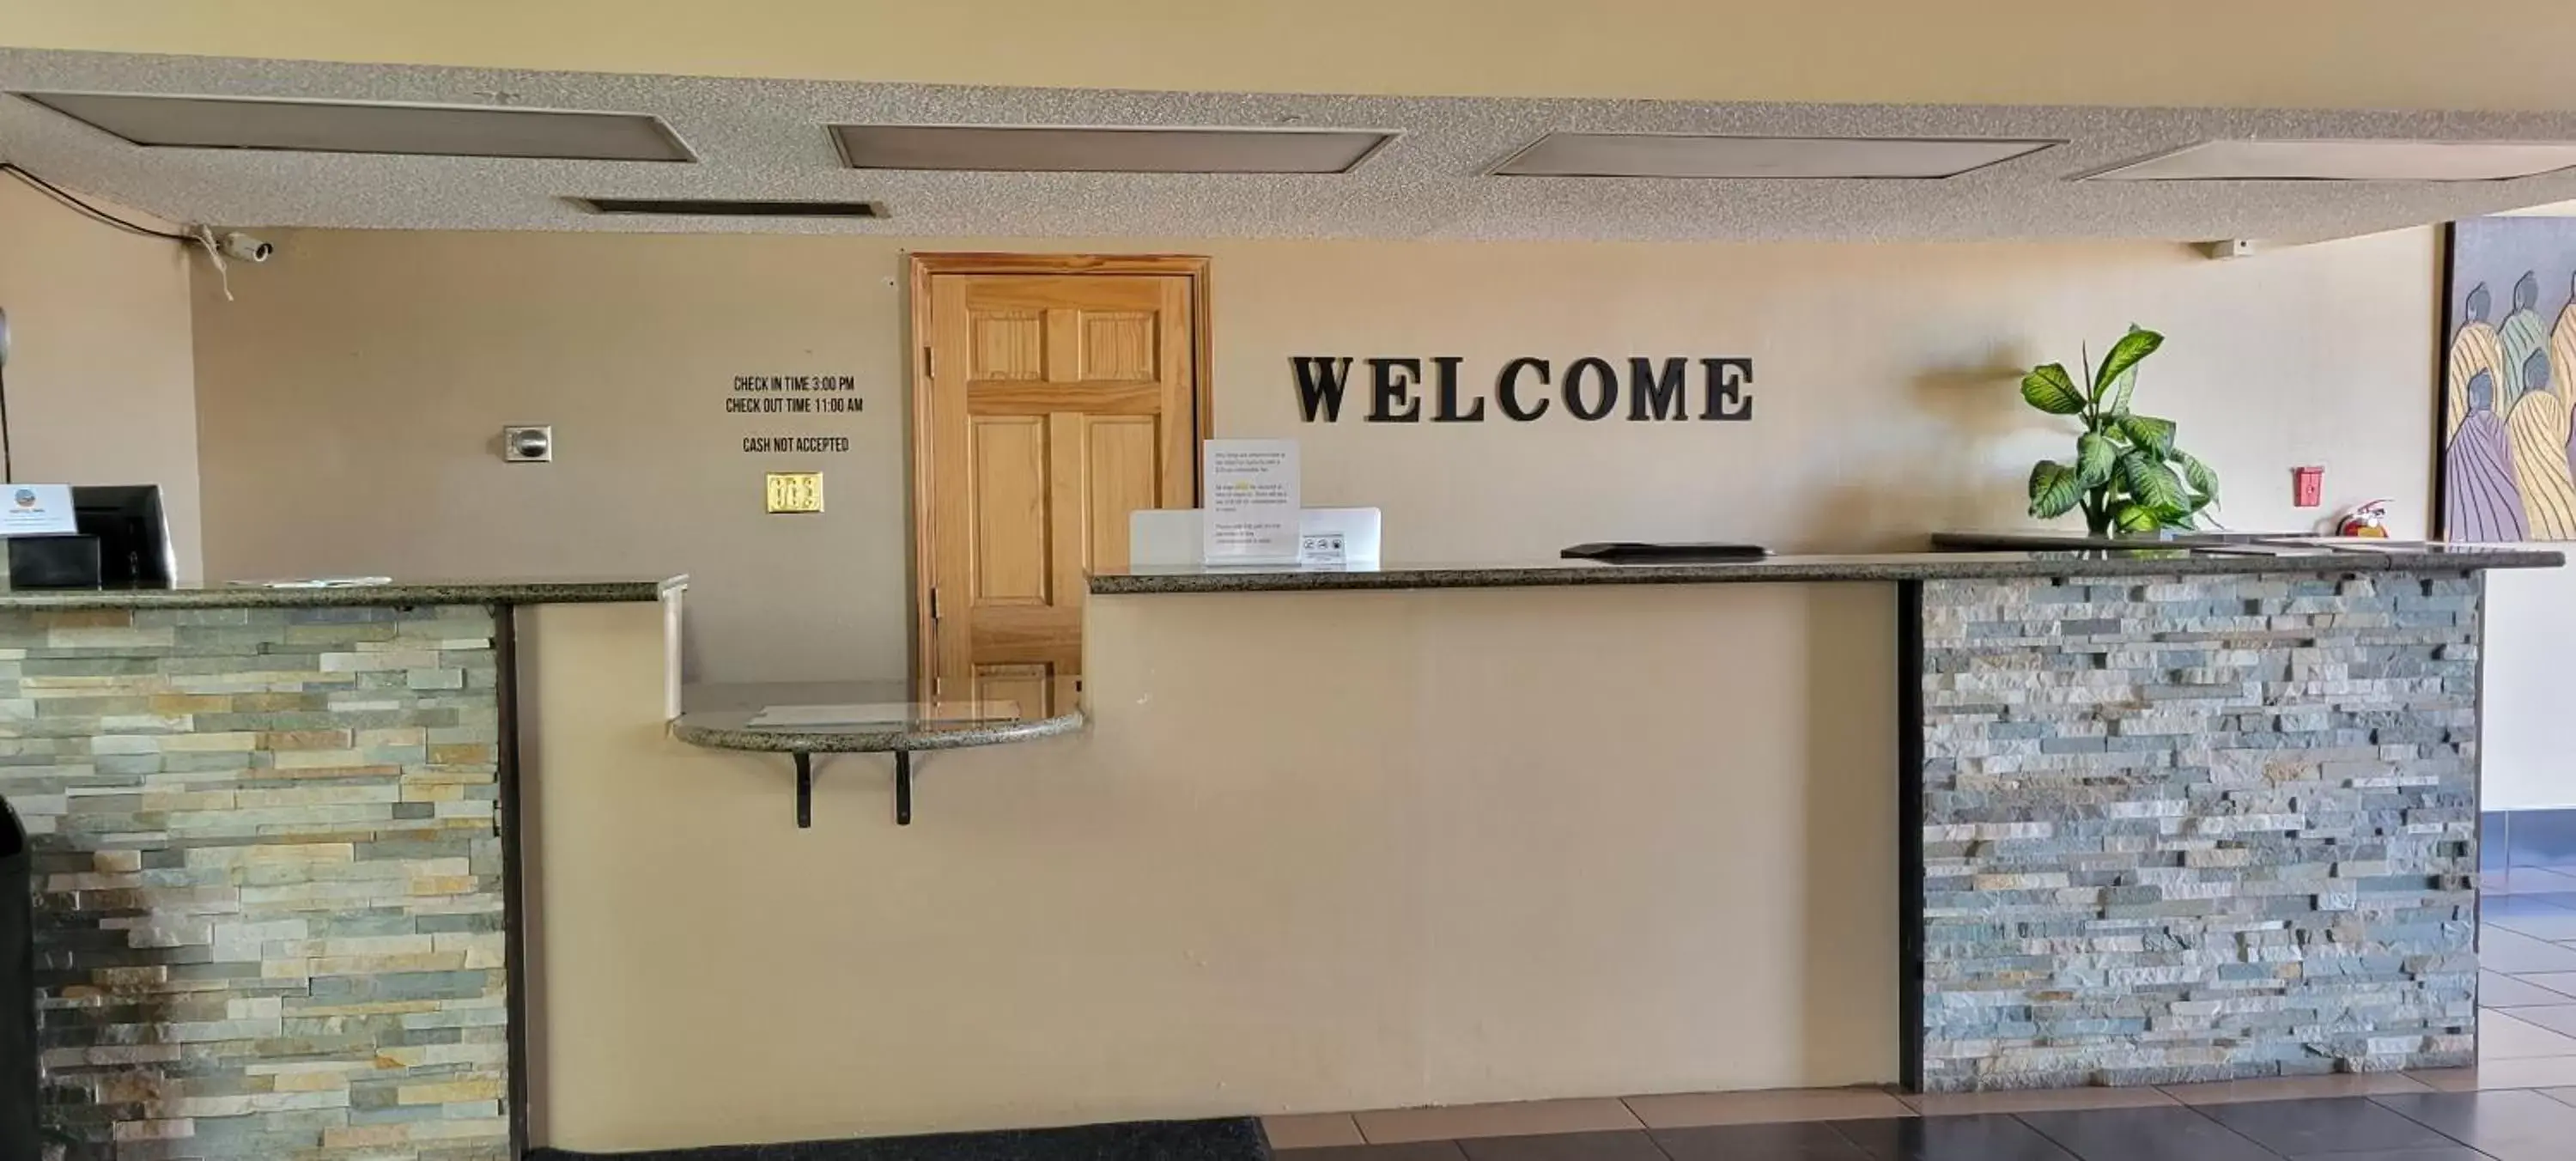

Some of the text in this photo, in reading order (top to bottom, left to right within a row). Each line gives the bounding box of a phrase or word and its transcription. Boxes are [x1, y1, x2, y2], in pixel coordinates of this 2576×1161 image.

[734, 375, 854, 391] CHECK IN TIME 3:00 PM
[1288, 356, 1753, 422] WELCOME
[726, 398, 863, 413] CHECK OUT TIME 11:00 AM
[743, 437, 849, 453] CASH NOT ACCEPTED
